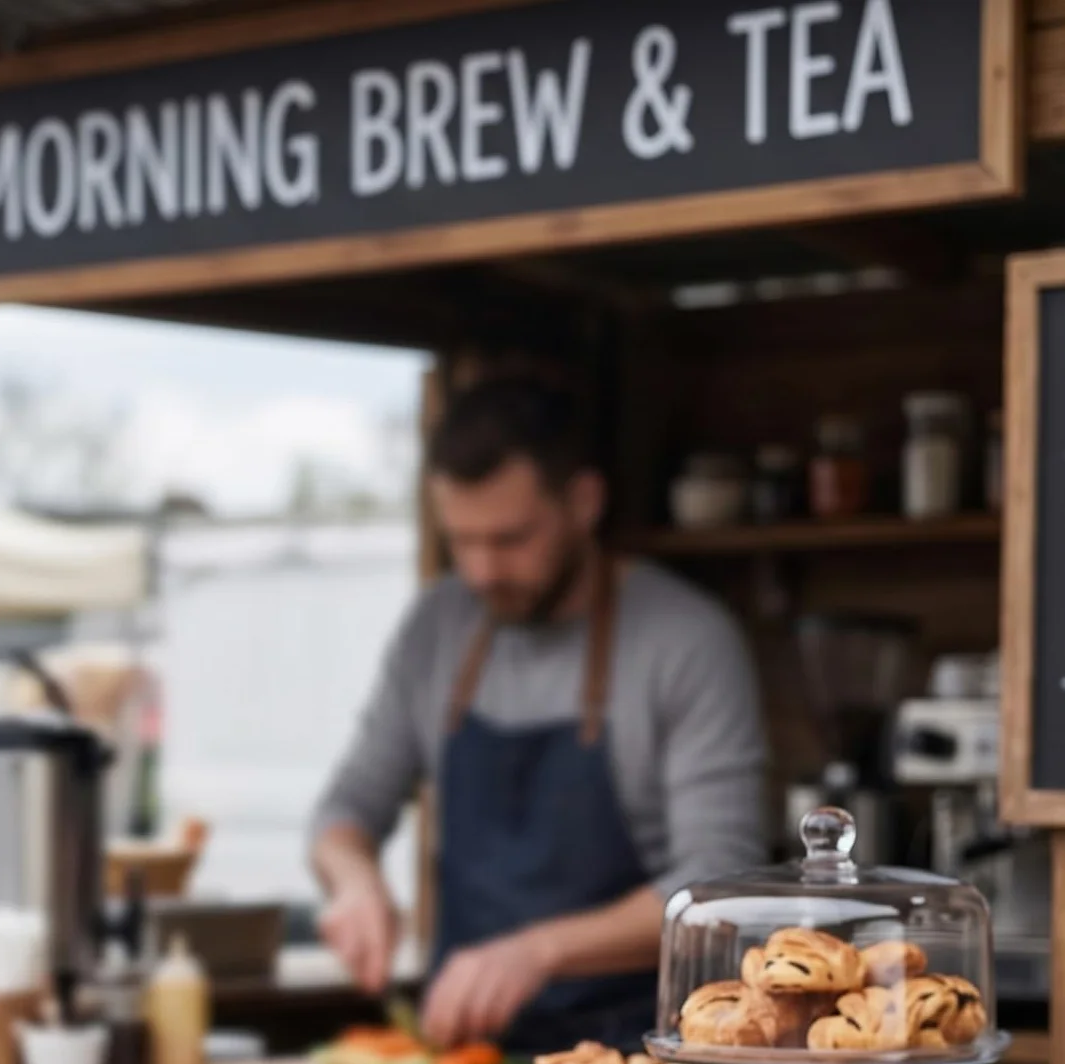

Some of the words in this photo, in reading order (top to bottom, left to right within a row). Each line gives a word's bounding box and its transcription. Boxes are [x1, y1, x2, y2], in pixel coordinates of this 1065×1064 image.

[351, 39, 590, 196] BREW
[622, 26, 694, 159] &
[727, 0, 913, 144] TEA
